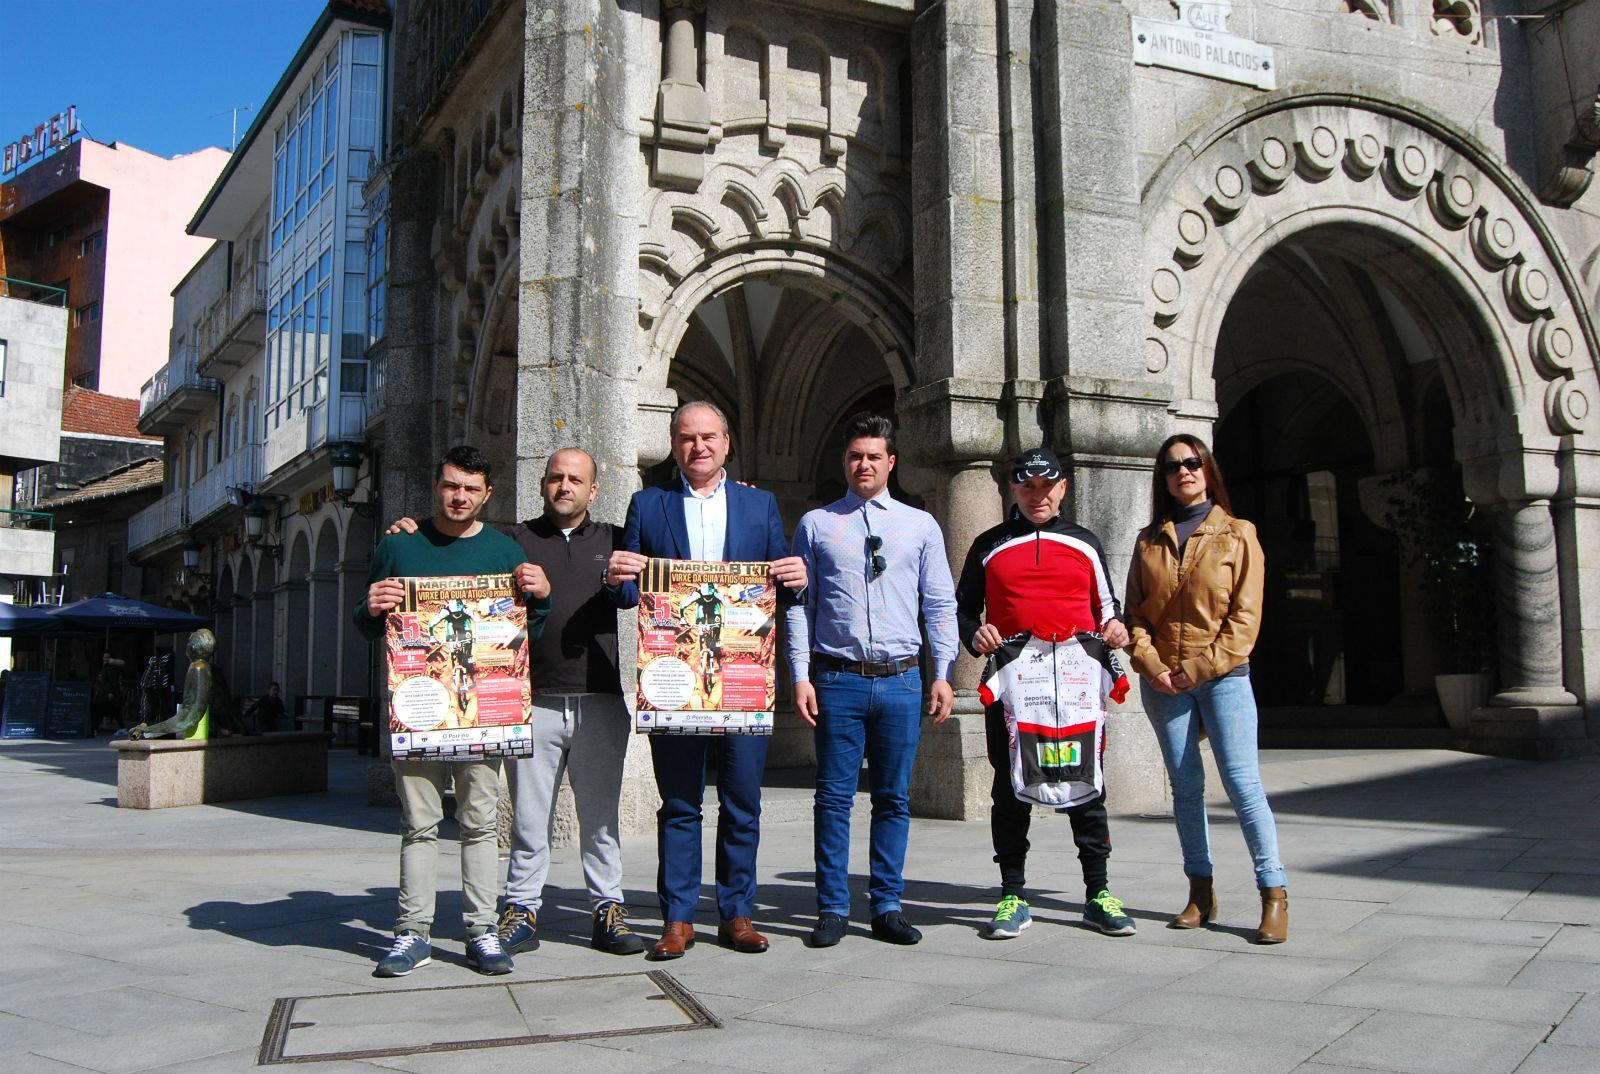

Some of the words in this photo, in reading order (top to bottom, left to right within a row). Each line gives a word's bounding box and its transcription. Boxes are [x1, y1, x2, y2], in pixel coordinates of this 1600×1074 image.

[1187, 3, 1220, 31] CALLE
[1150, 33, 1201, 59] ANTONIO
[1206, 45, 1259, 71] PALACIOS
[2, 104, 81, 175] HOTEL
[672, 573, 692, 583] VIRXE
[693, 574, 702, 583] DA
[719, 574, 738, 584] ATIOS
[673, 563, 726, 572] MARCHA
[730, 563, 771, 576] BTT
[418, 590, 439, 601] VIRXE
[440, 590, 448, 600] DA
[468, 589, 487, 599] ATIOS
[419, 579, 474, 589] MARCHA
[476, 576, 515, 589] BTT
[654, 595, 671, 620] 5
[402, 615, 420, 640] 5
